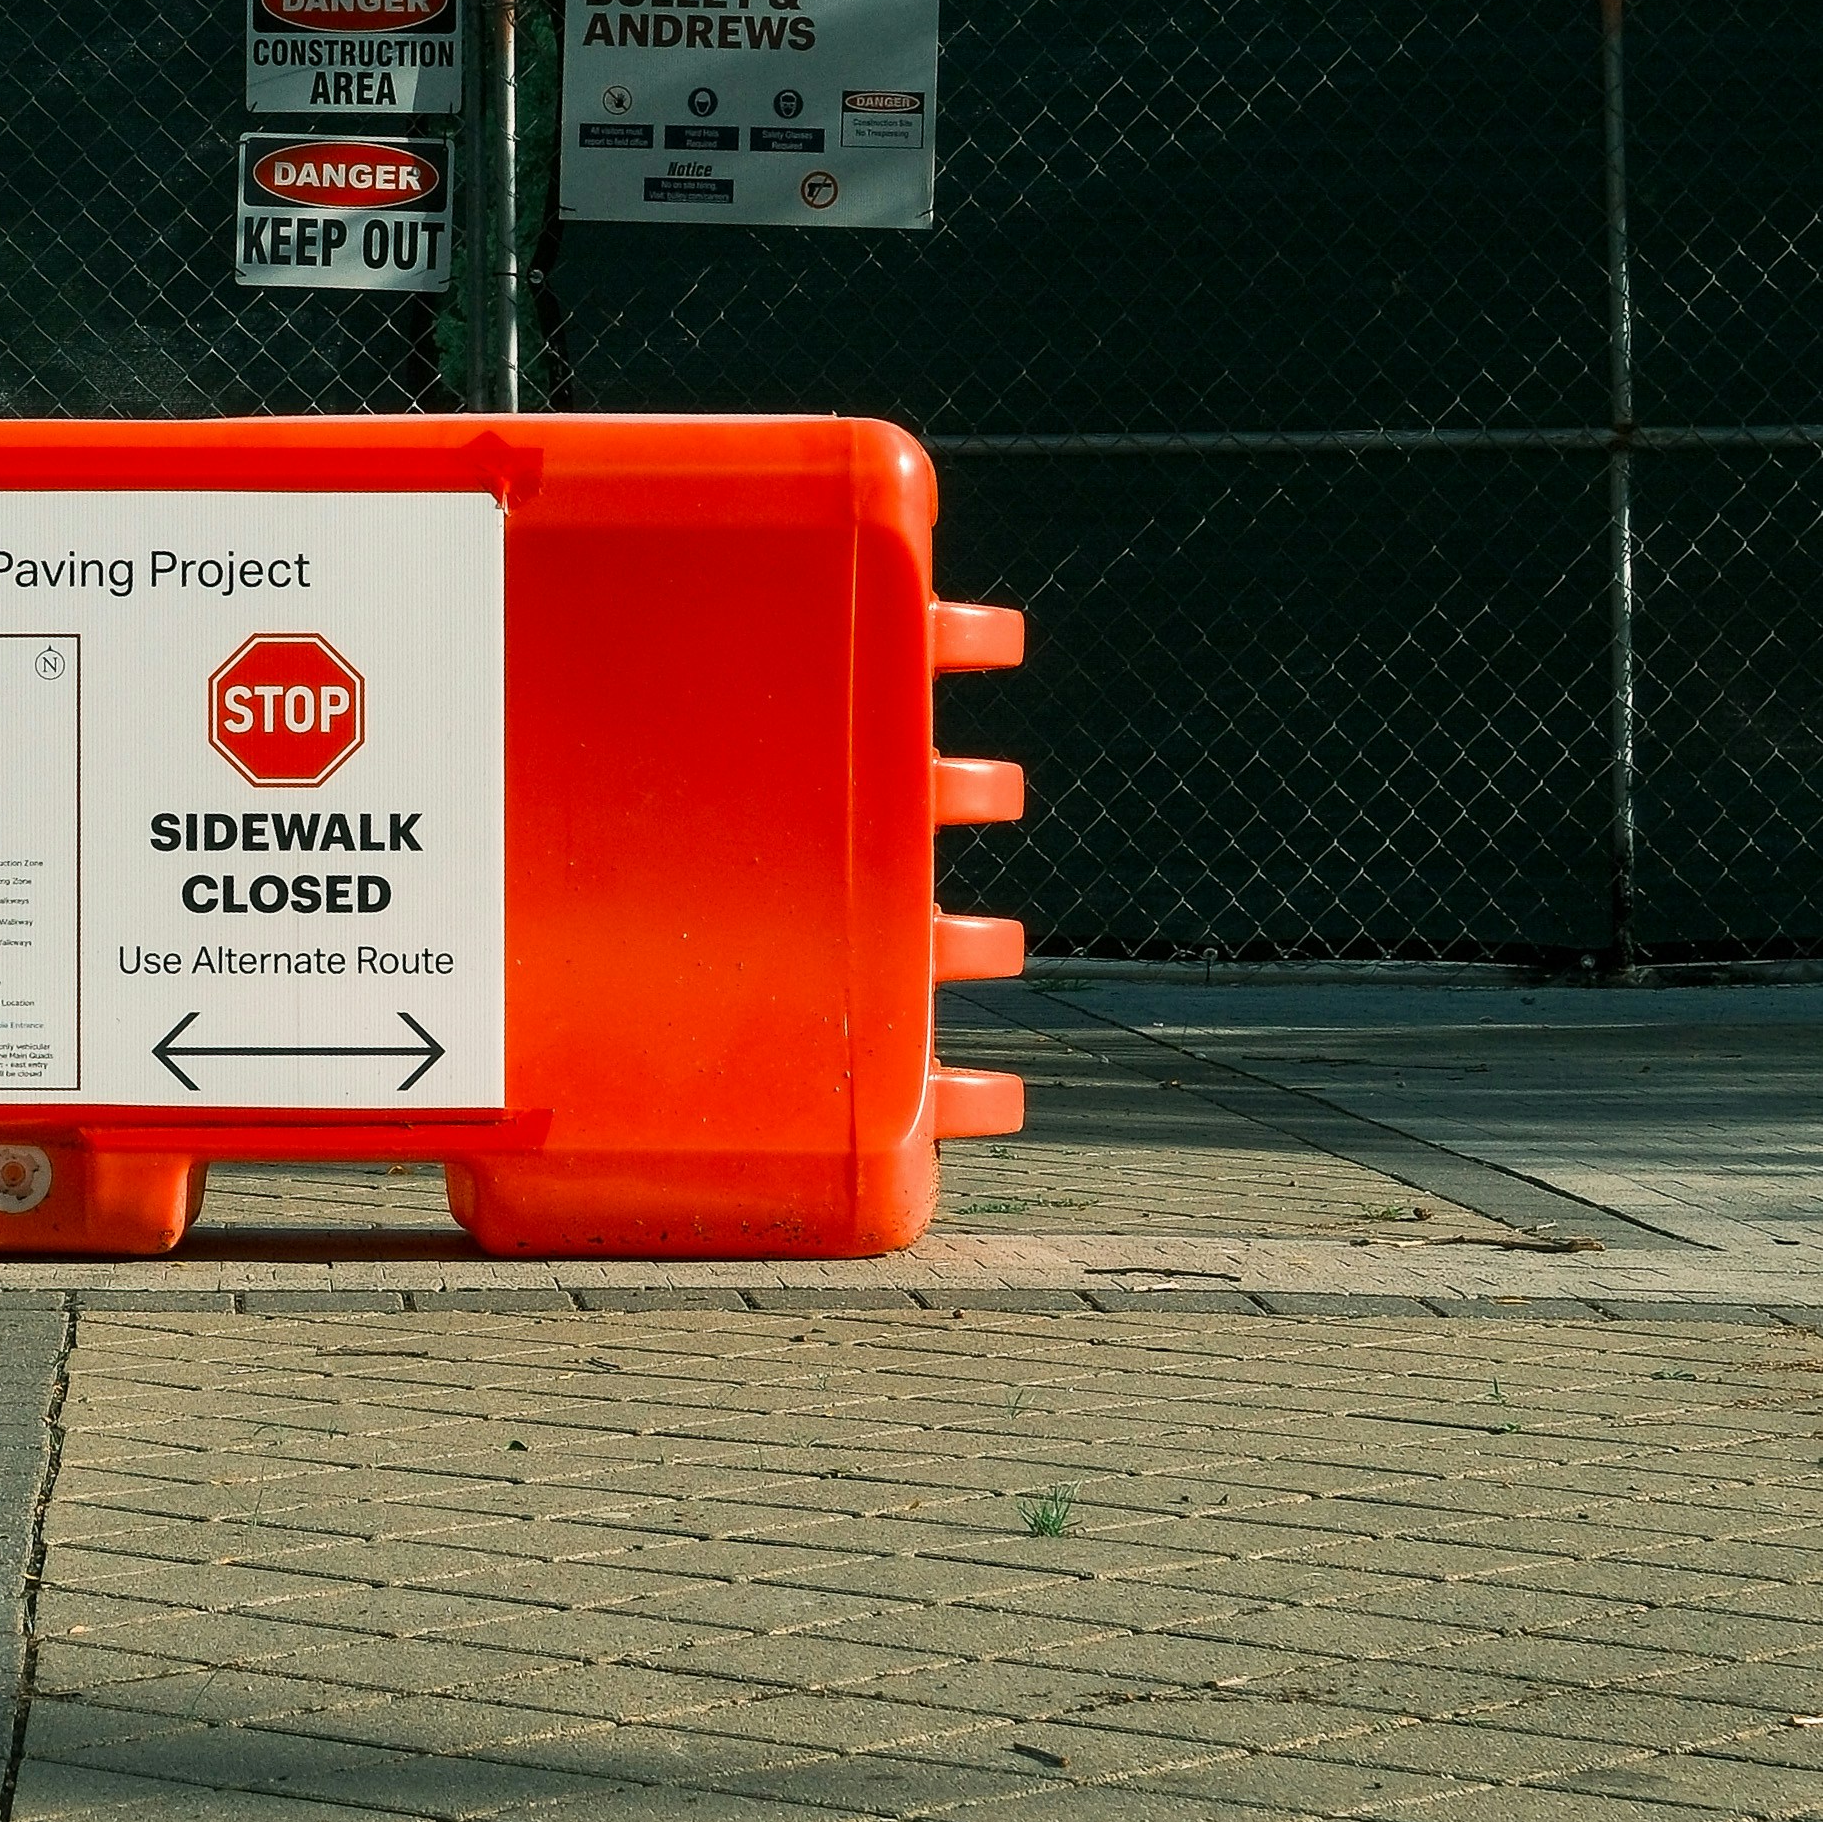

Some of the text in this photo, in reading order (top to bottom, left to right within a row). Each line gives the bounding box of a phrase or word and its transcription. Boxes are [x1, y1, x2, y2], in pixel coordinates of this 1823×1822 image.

[582, 13, 816, 51] ANDREWS
[253, 39, 454, 67] CONSTRUCTION
[310, 71, 397, 105] AREA
[856, 97, 910, 108] DANGER
[853, 118, 898, 126] Construction
[856, 129, 909, 139] No Trespassing
[274, 161, 422, 191] DANGER
[667, 162, 713, 177] Notice
[661, 180, 672, 188] No
[243, 216, 445, 270] KEEP OUT
[150, 550, 311, 597] Project
[42, 657, 58, 673] N
[223, 685, 351, 734] STOP
[150, 812, 424, 852] SIDEWALK
[24, 859, 44, 867] Zone
[182, 874, 392, 914] CLOSED
[0, 918, 33, 927] Walkway
[119, 946, 454, 975] Use Alternate Route
[1, 999, 35, 1007] Location
[28, 1062, 48, 1070] entry
